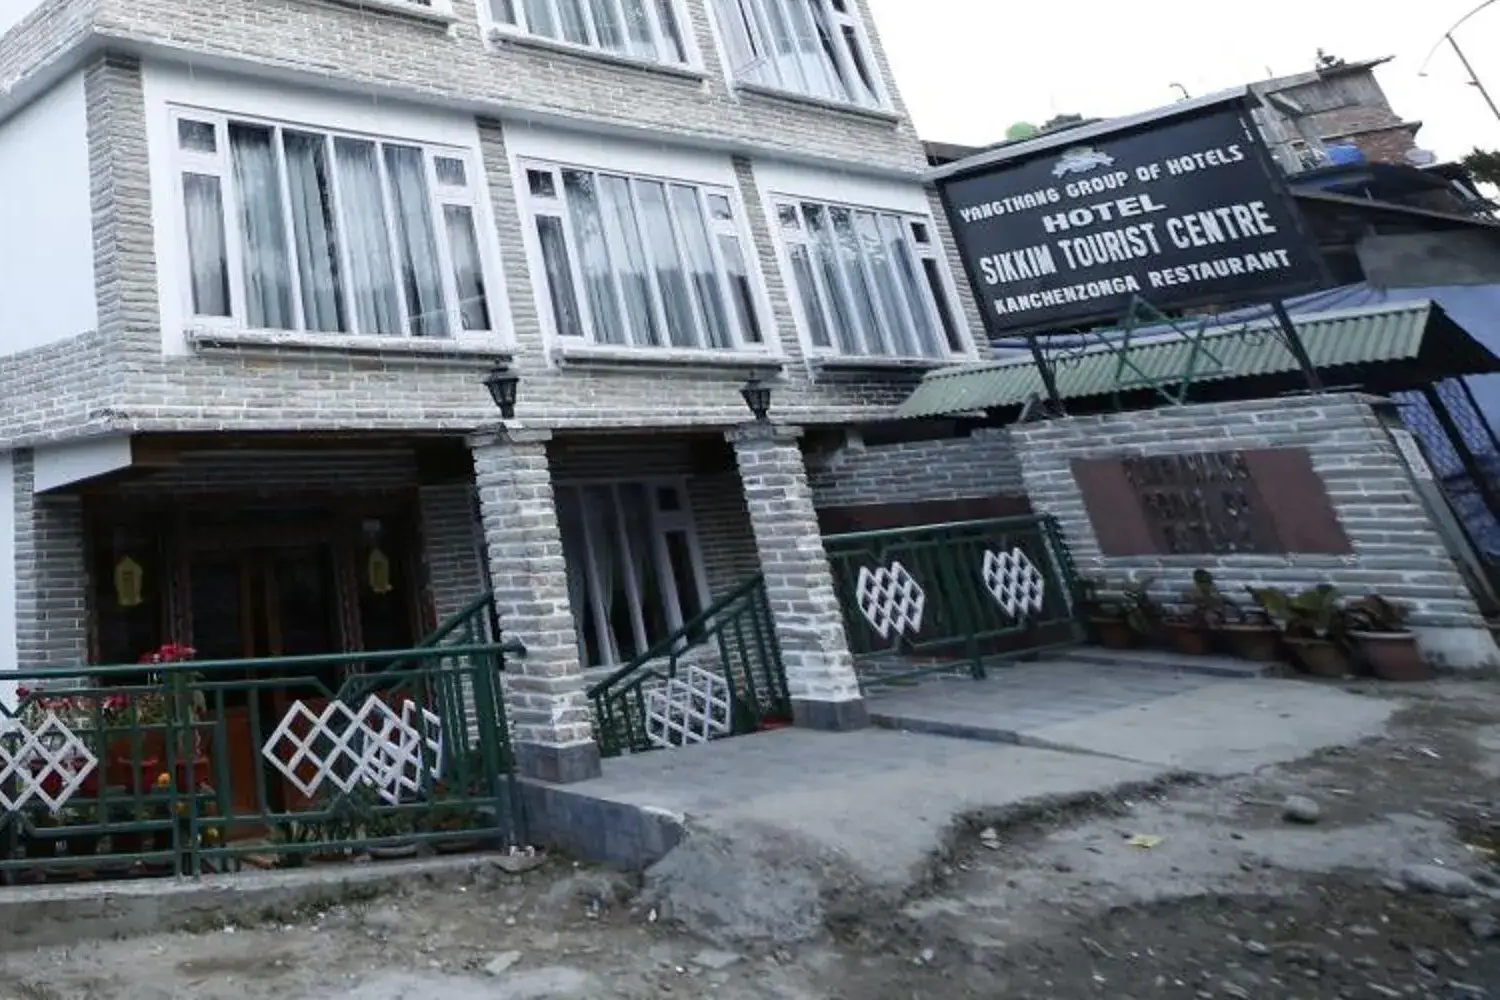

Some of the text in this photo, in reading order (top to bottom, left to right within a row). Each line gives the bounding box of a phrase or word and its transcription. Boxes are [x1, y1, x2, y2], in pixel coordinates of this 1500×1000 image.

[959, 144, 1244, 223] YANGTHANG GROUP OF HOTELS
[1041, 193, 1168, 233] HOTEL
[979, 200, 1277, 285] SIKKIM TOURIST CENTRE
[993, 248, 1291, 315] KANCHENZONGA RESTAURANT
